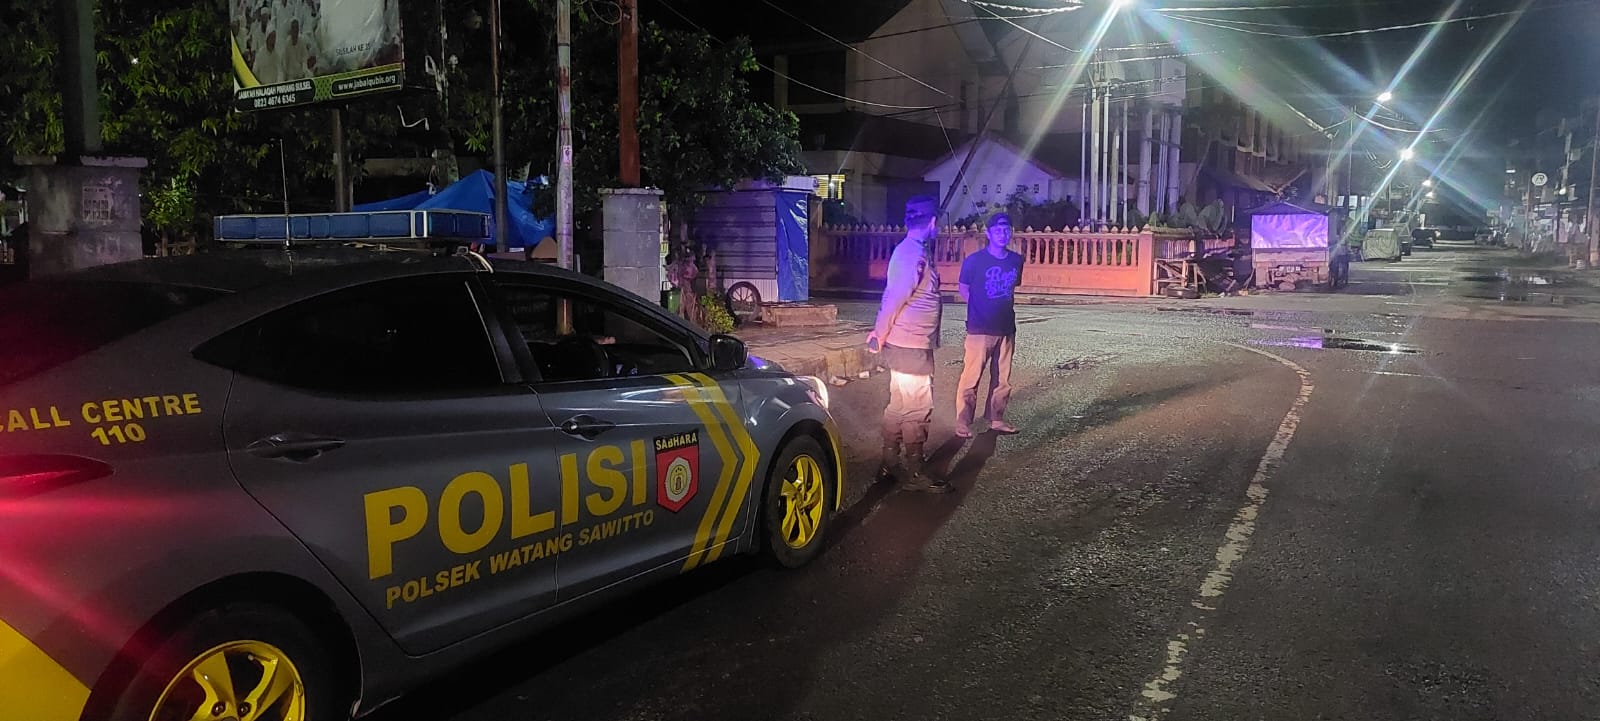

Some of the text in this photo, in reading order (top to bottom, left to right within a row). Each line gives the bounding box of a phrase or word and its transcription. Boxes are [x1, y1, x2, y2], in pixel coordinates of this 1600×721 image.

[81, 393, 202, 424] CENTRE
[91, 422, 147, 446] 110
[655, 432, 698, 451] SABHARA
[363, 439, 648, 580] POLISI
[386, 508, 655, 610] POLSEK WATANG SAWITTO
